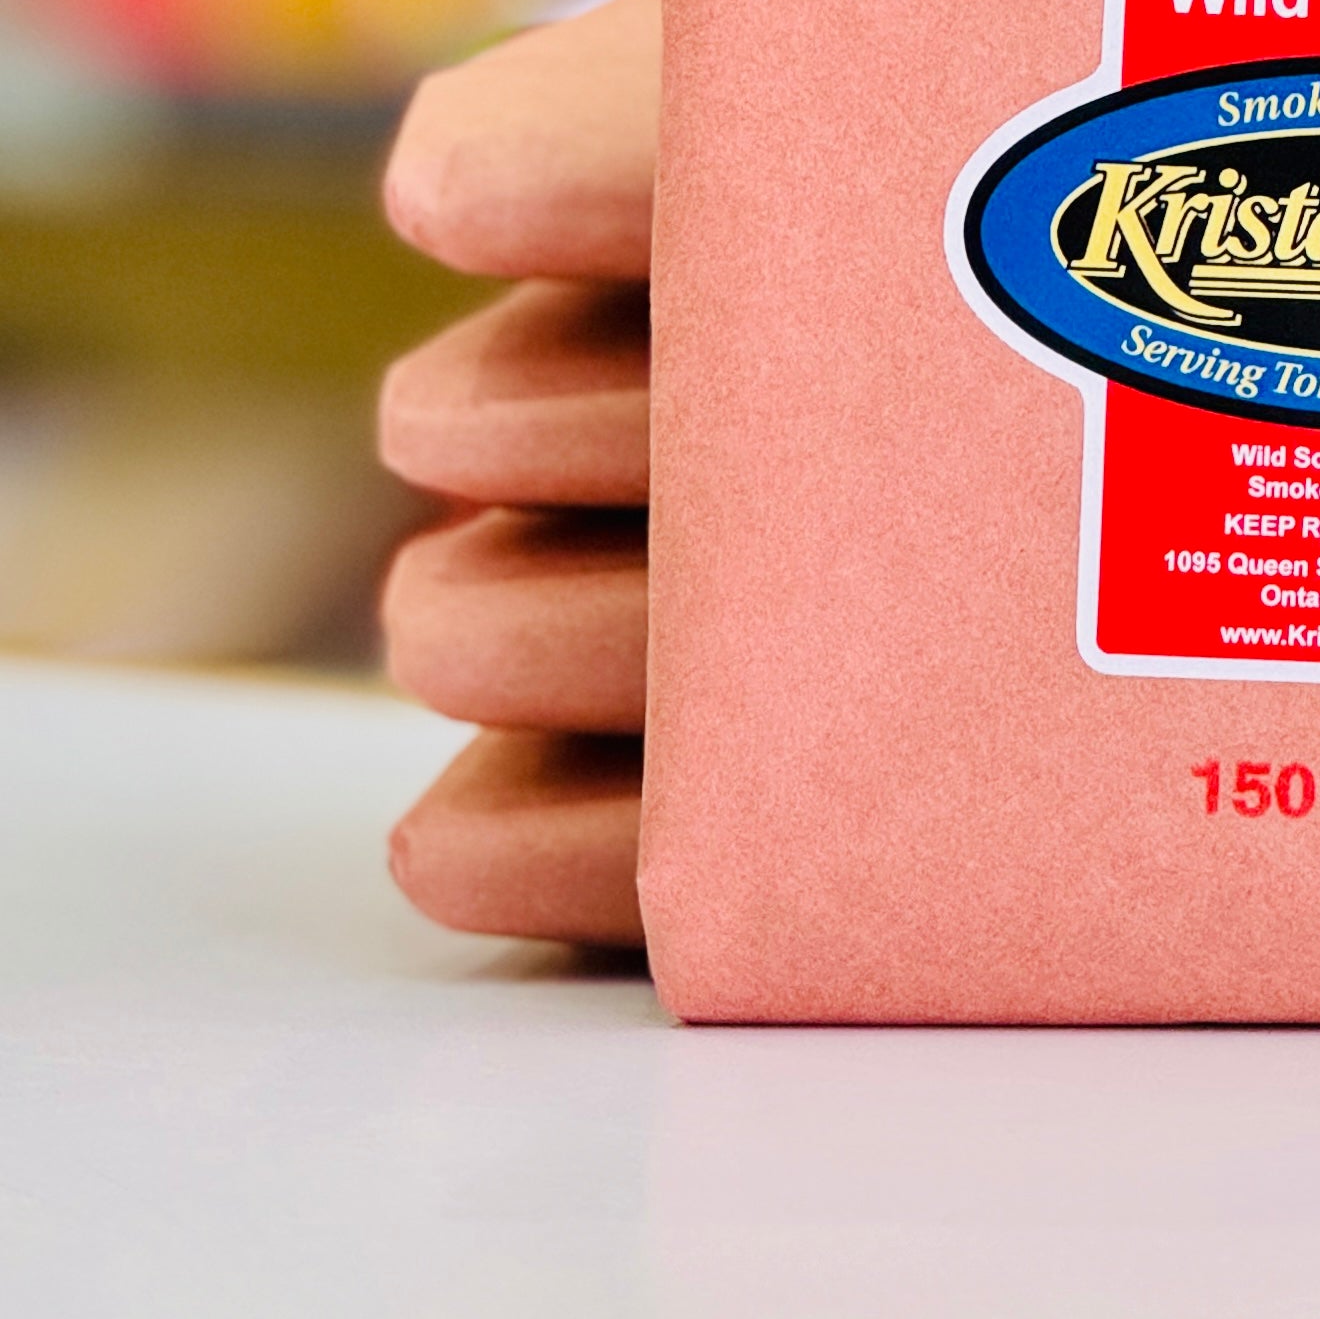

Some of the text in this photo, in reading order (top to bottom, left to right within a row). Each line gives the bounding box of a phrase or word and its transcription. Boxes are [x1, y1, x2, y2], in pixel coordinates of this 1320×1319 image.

[1121, 324, 1265, 397] Serving
[1232, 444, 1286, 468] Wild
[1224, 514, 1295, 537] KEEP
[1164, 550, 1221, 573] 1095
[1228, 553, 1308, 579] Queen
[1192, 760, 1316, 818] 150
